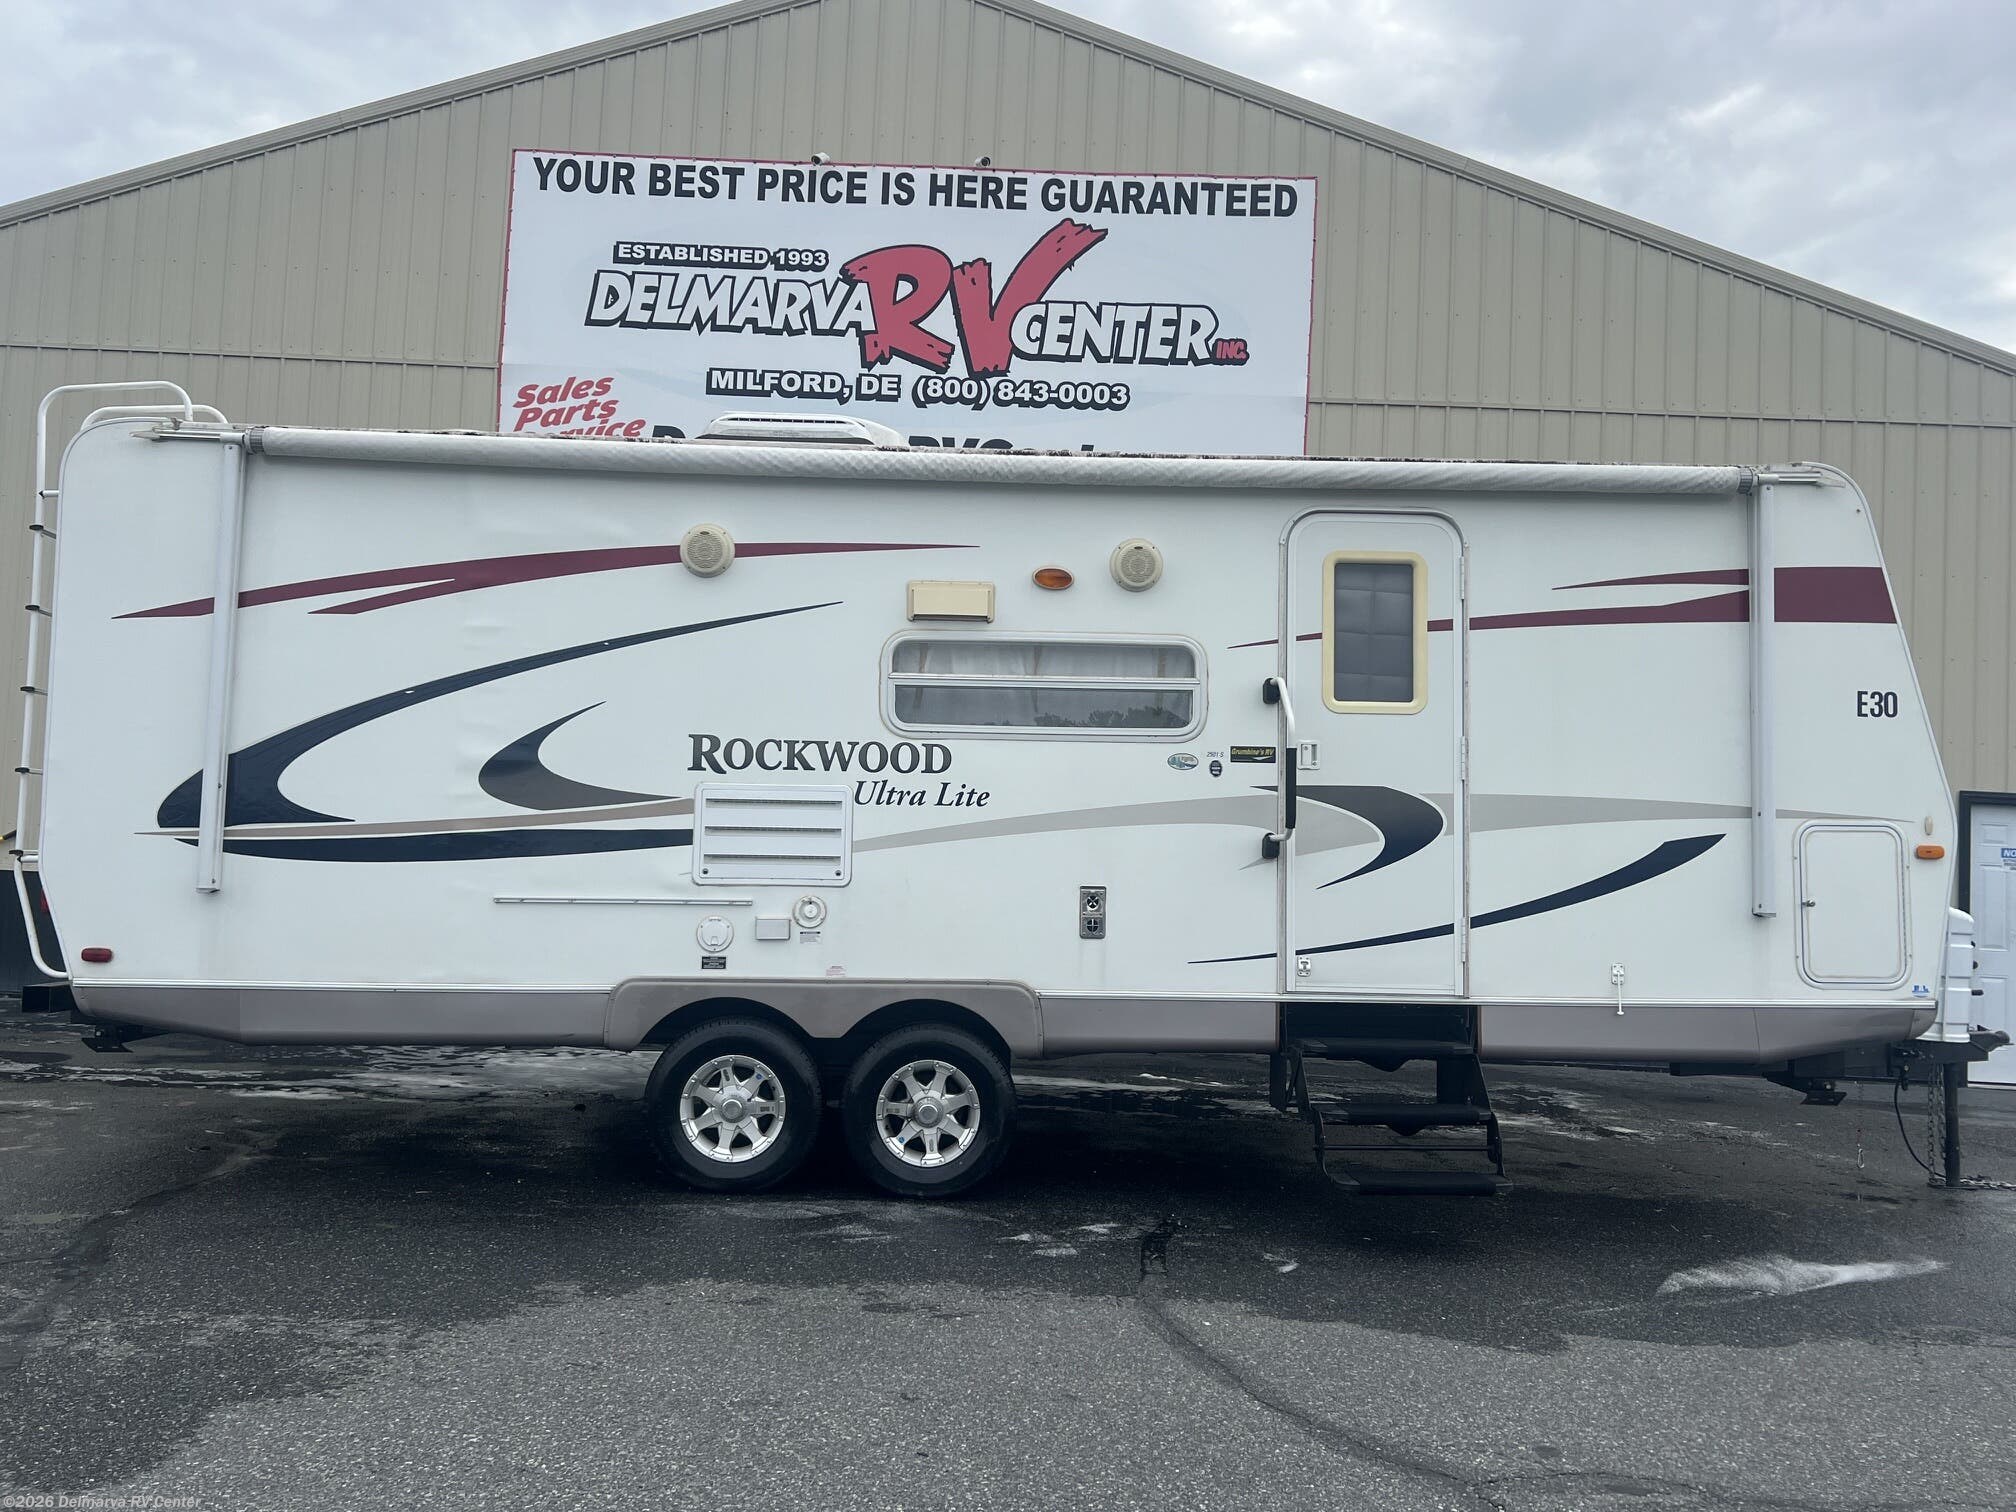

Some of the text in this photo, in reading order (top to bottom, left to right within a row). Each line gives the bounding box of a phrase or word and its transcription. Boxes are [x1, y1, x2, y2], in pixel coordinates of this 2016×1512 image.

[533, 157, 1298, 217] YOUR BEST PRICE IS HERE GUARANTEED
[615, 242, 828, 269] ESTABLISHED 1993
[586, 218, 1249, 378] DELMARVA RV CENTER INC.
[513, 376, 614, 409] Sales
[709, 369, 1129, 407] MILFORD, DE (800) 843-0003
[513, 399, 619, 432] Parts
[1857, 691, 1898, 718] E30
[687, 733, 953, 775] ROCKWOOD
[854, 780, 991, 807] Ultra Lite
